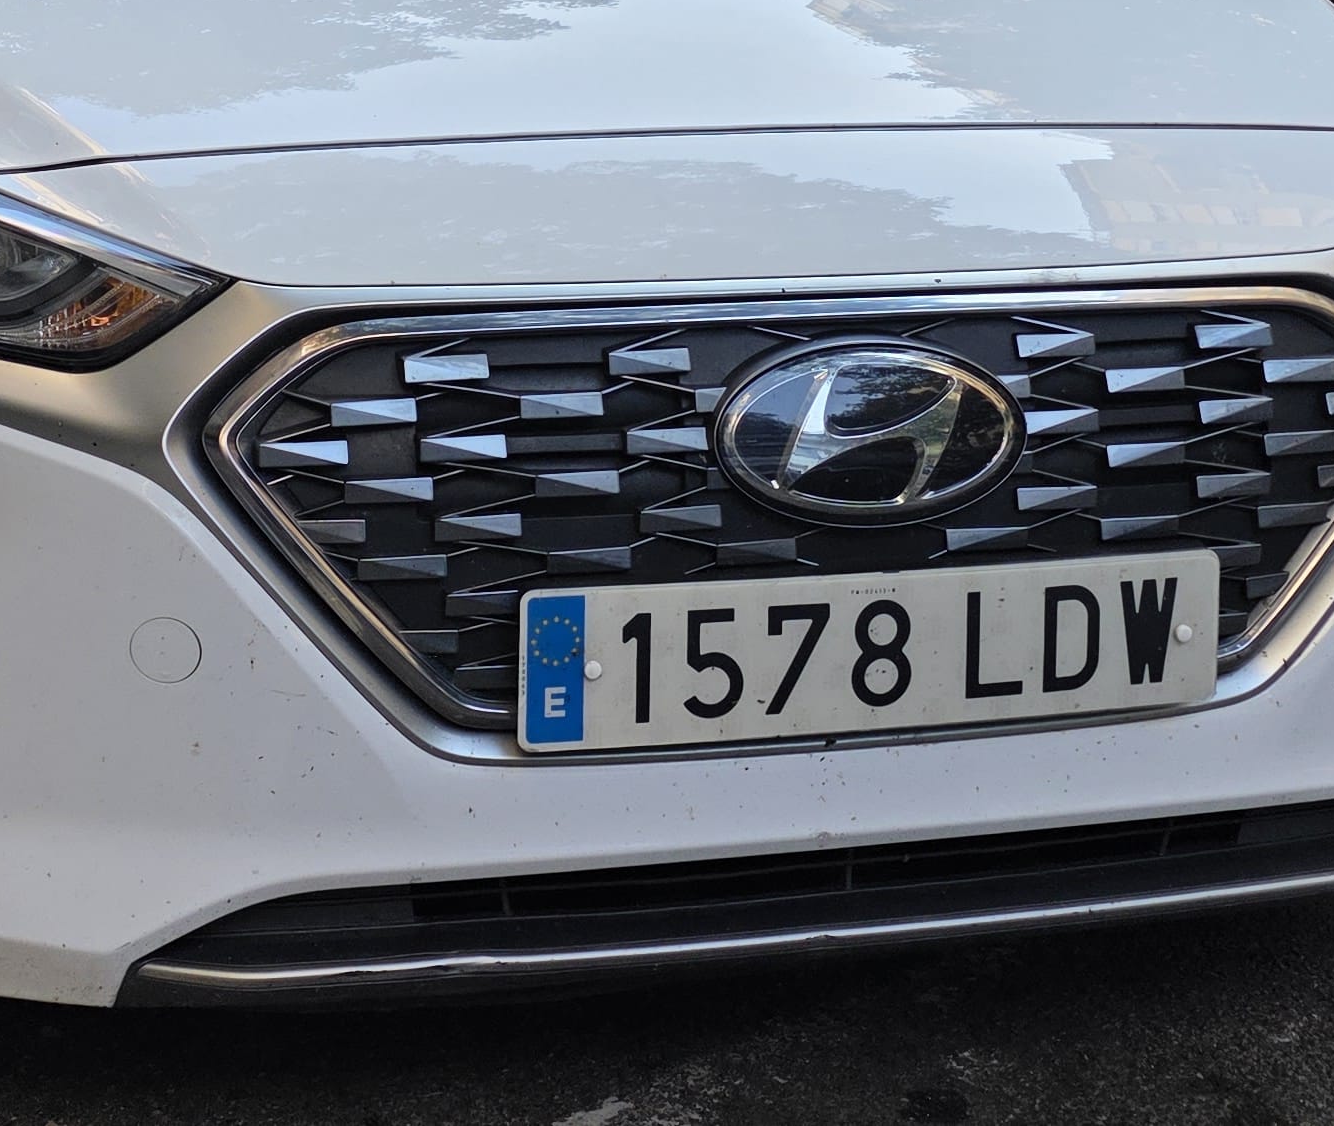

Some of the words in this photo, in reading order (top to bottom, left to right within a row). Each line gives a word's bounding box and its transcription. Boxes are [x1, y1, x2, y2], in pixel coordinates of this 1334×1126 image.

[544, 686, 567, 718] E
[622, 599, 913, 724] 1578
[965, 577, 1178, 700] LDW
